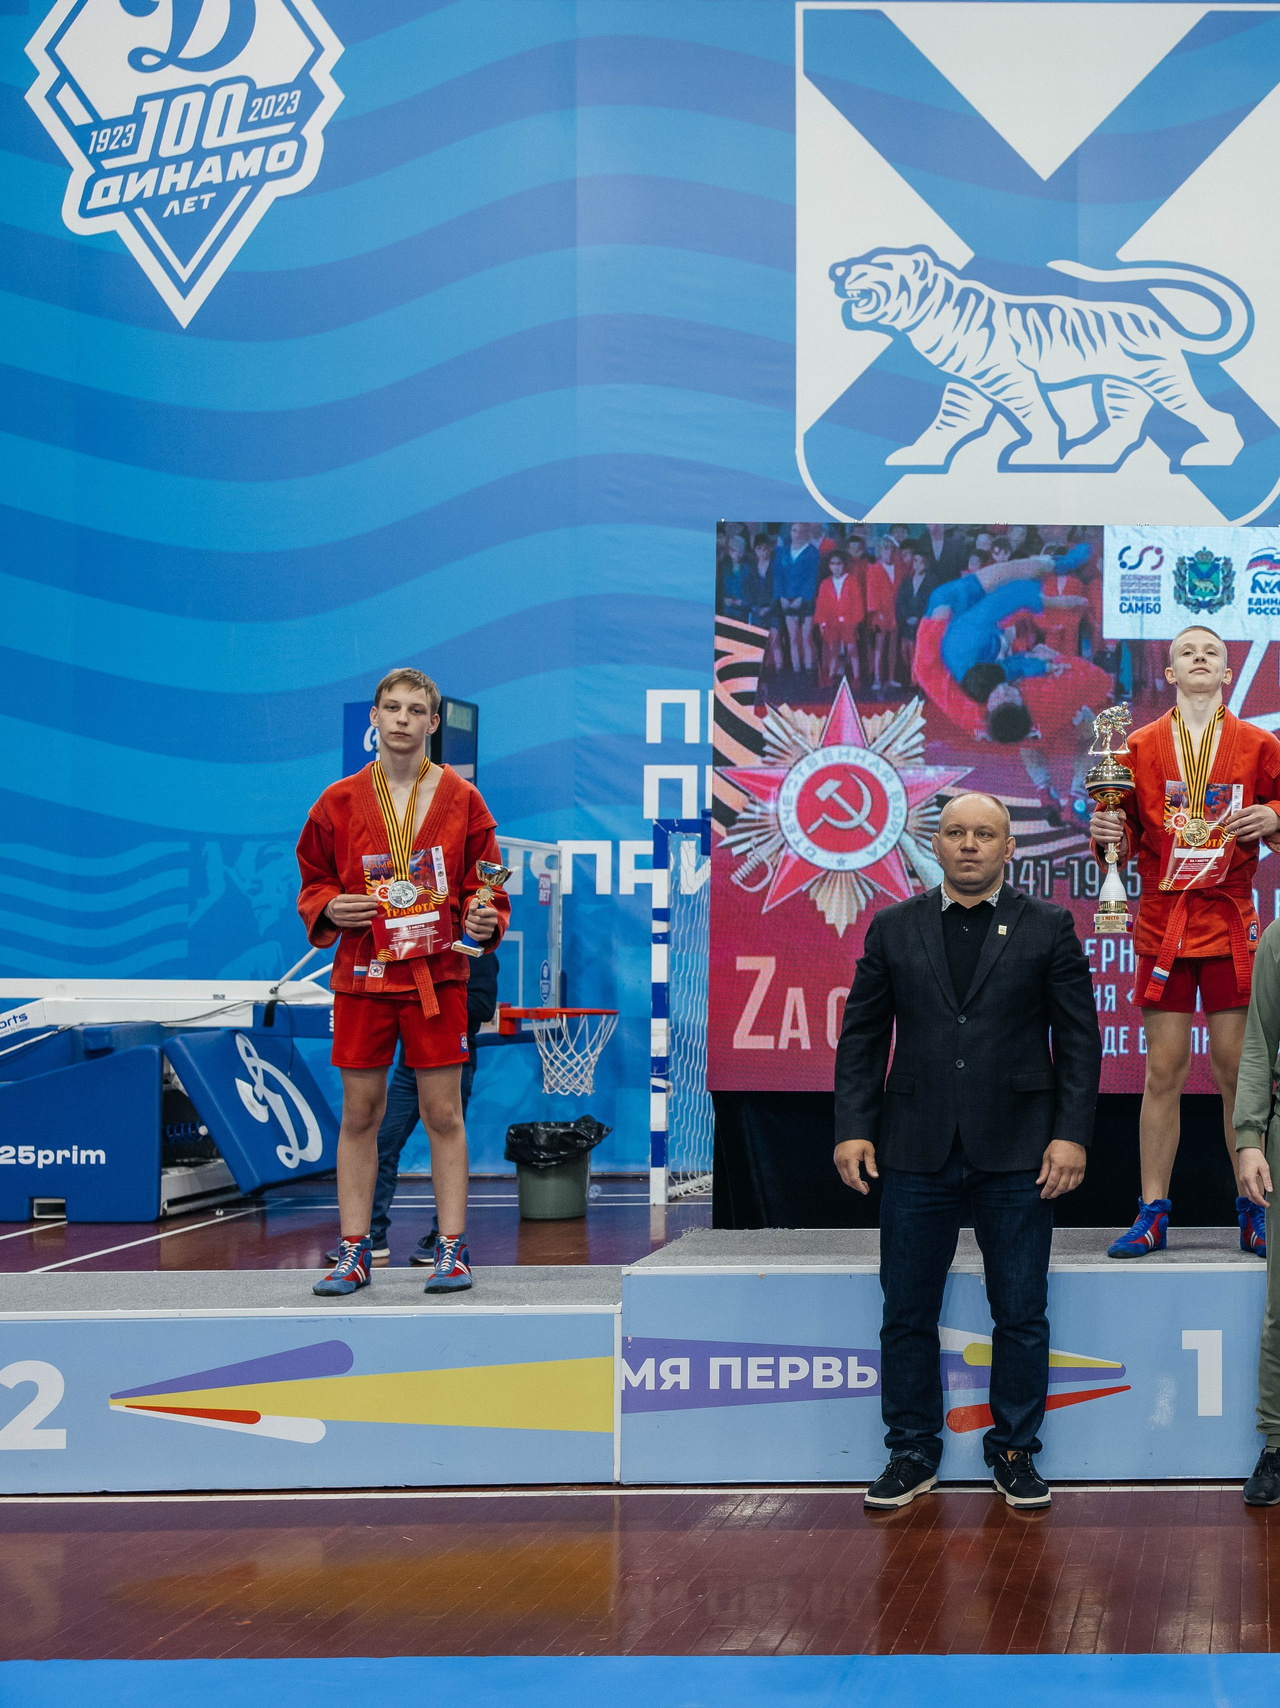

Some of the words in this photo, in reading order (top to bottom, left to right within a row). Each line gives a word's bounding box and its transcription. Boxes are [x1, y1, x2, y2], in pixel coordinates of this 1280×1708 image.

[139, 82, 250, 162] 100
[247, 89, 302, 123] 2023
[88, 122, 137, 155] 1923
[86, 139, 299, 210] ДИНАМО
[162, 191, 216, 218] ЛЕТ
[1119, 601, 1162, 615] САМБО
[386, 902, 435, 918] ГРАМОТА
[0, 1145, 106, 1169] 25prim
[1181, 1330, 1223, 1417] 1
[0, 1360, 66, 1451] 2
